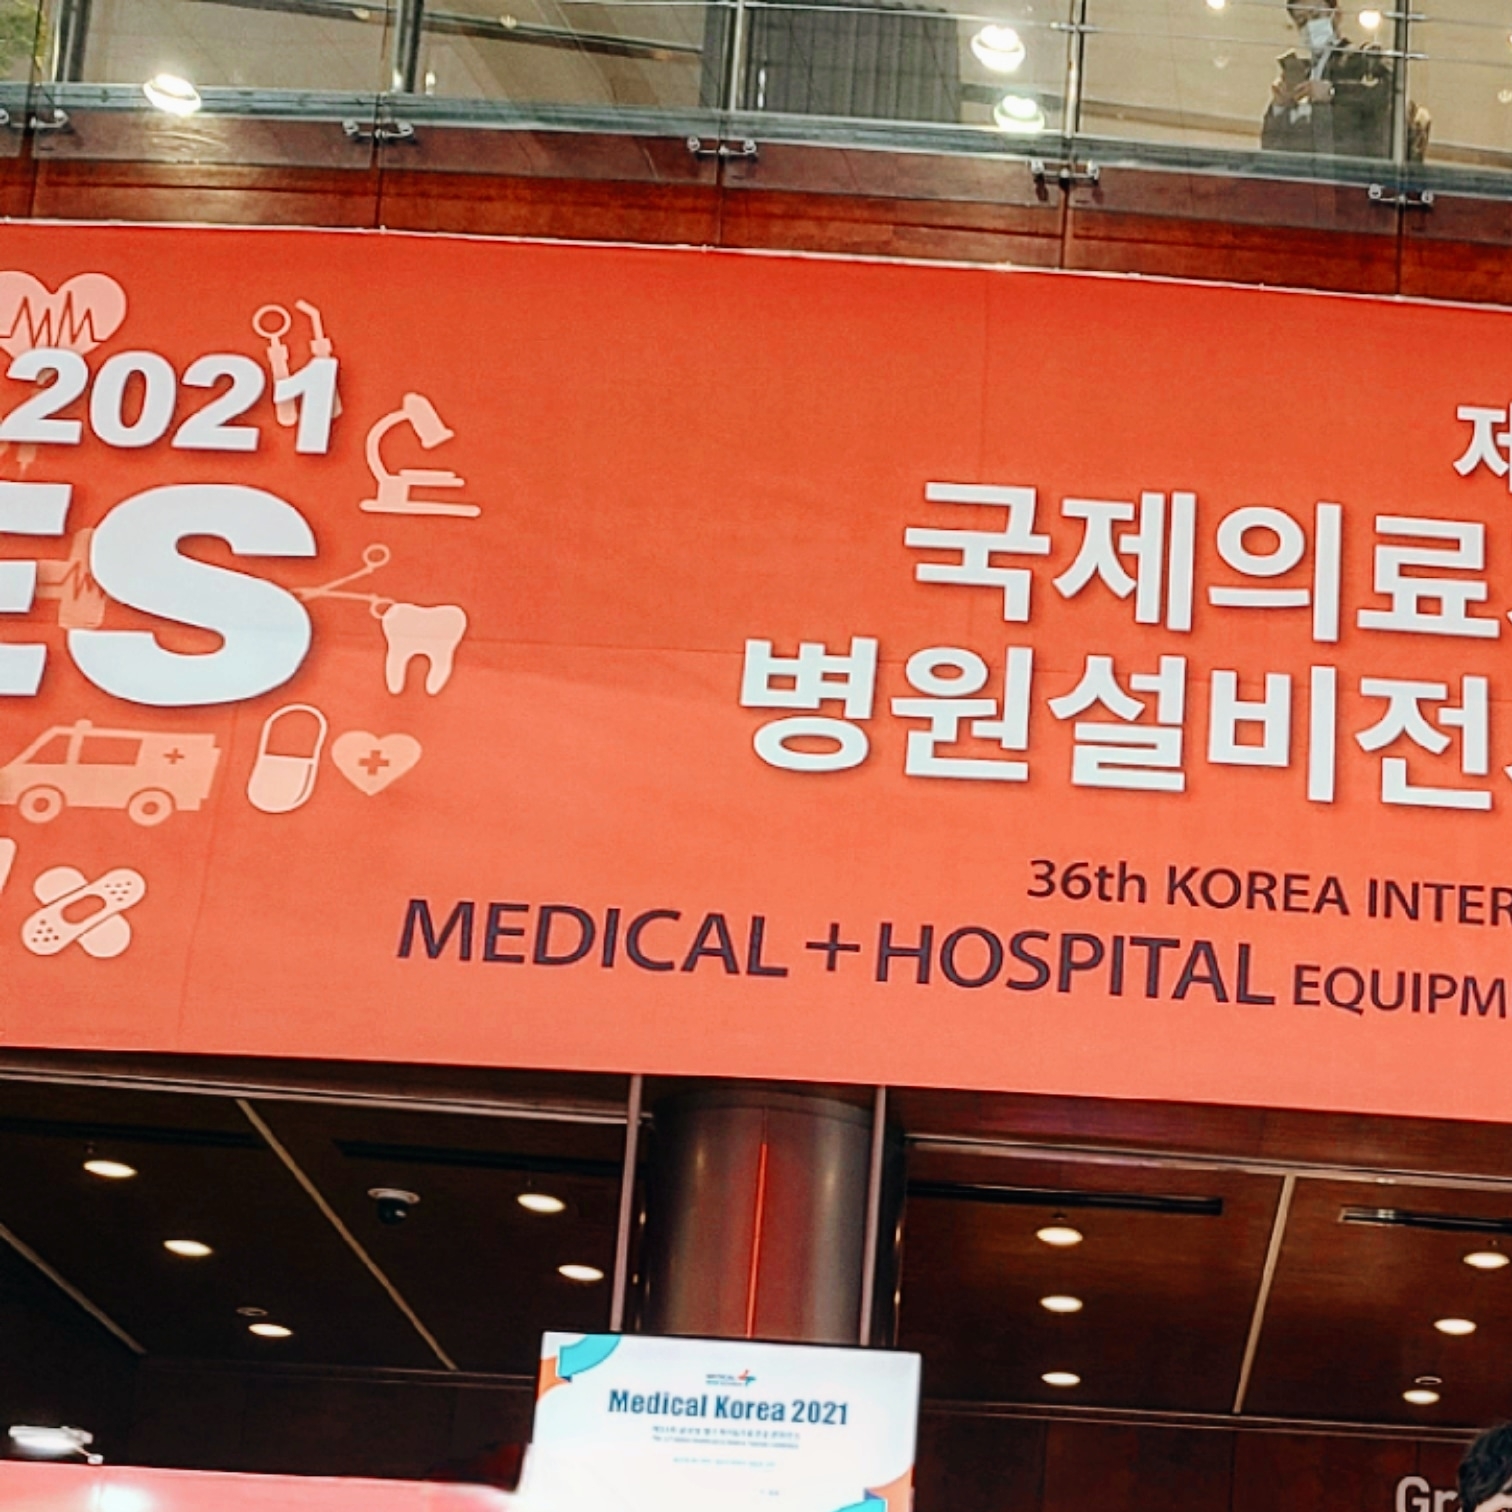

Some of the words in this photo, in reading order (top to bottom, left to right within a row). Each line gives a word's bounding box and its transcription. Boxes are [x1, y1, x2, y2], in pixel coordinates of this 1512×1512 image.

[0, 349, 339, 454] 2021
[1027, 859, 1146, 903] 36th
[1167, 866, 1350, 917] KOREA
[397, 899, 788, 977] MEDICAL
[875, 922, 1276, 1008] HOSPITAL
[608, 1388, 708, 1419] Medical
[714, 1395, 785, 1421] Korea
[791, 1400, 849, 1426] 2021
